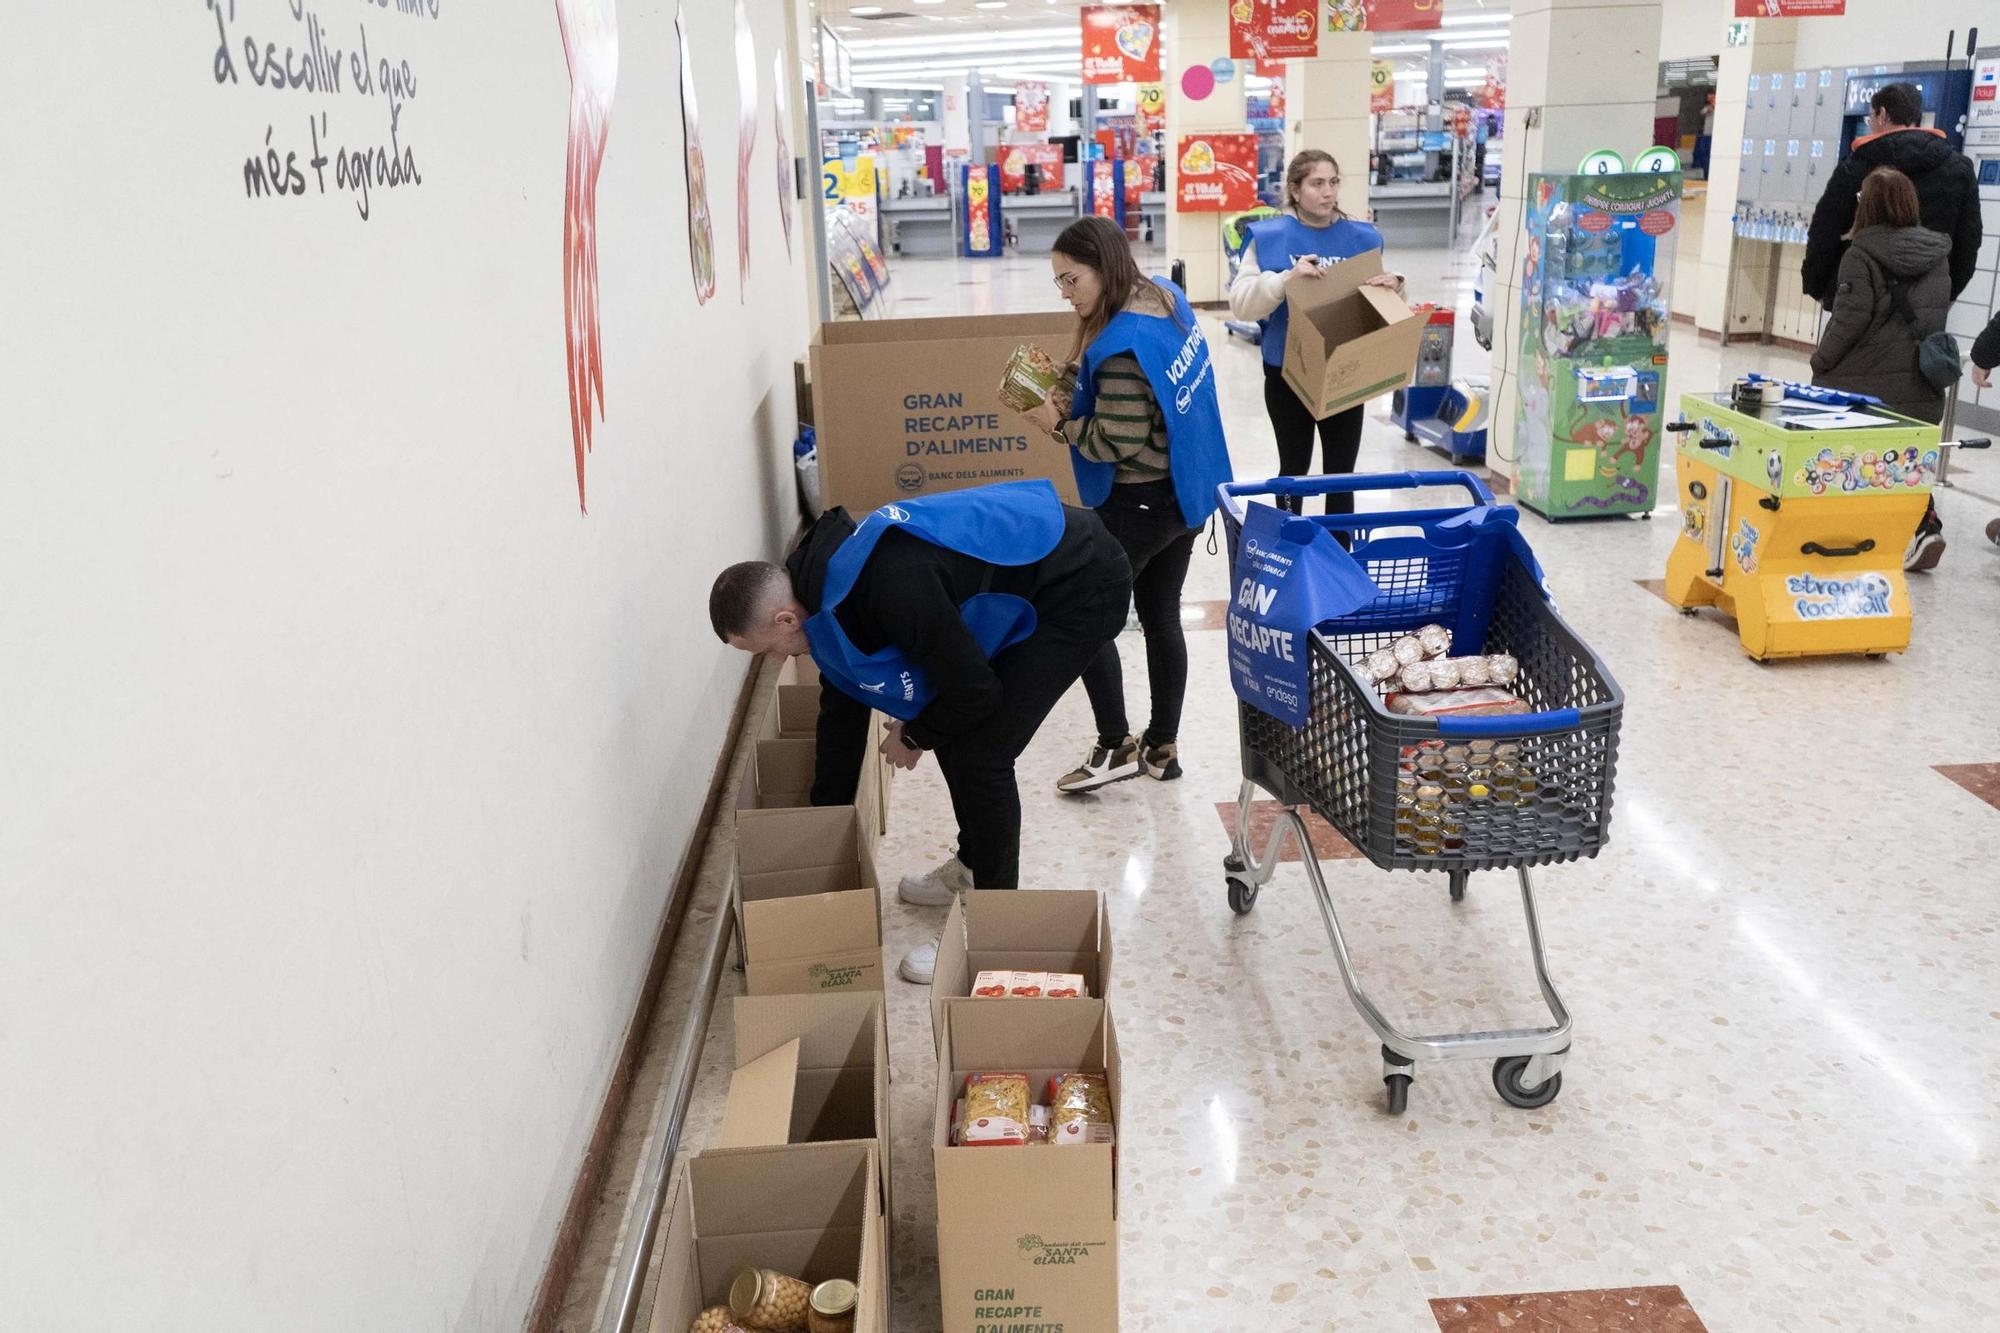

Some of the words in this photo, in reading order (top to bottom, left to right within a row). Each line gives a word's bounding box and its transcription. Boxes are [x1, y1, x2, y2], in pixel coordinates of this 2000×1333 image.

[214, 1, 343, 94] d'escollir
[350, 22, 374, 97] el
[379, 58, 417, 132] que
[1141, 89, 1159, 102] 70
[243, 124, 306, 199] més
[310, 110, 422, 222] t'agrada
[903, 392, 963, 410] GRAN
[904, 413, 999, 433] RECAPTE
[906, 436, 1028, 456] D'ALIMENTS
[928, 471, 954, 481] BANC
[956, 470, 977, 479] DELS
[980, 468, 1025, 478] ALIMENTS
[1229, 612, 1295, 663] RECAPTE
[1266, 686, 1298, 708] endesa
[829, 969, 863, 981] SANTA
[820, 977, 853, 989] CLARA
[1045, 1247, 1089, 1257] SANTA
[1033, 1256, 1076, 1265] CLARA
[974, 1288, 1015, 1301] GRAN
[975, 1306, 1043, 1319] RECAPTE
